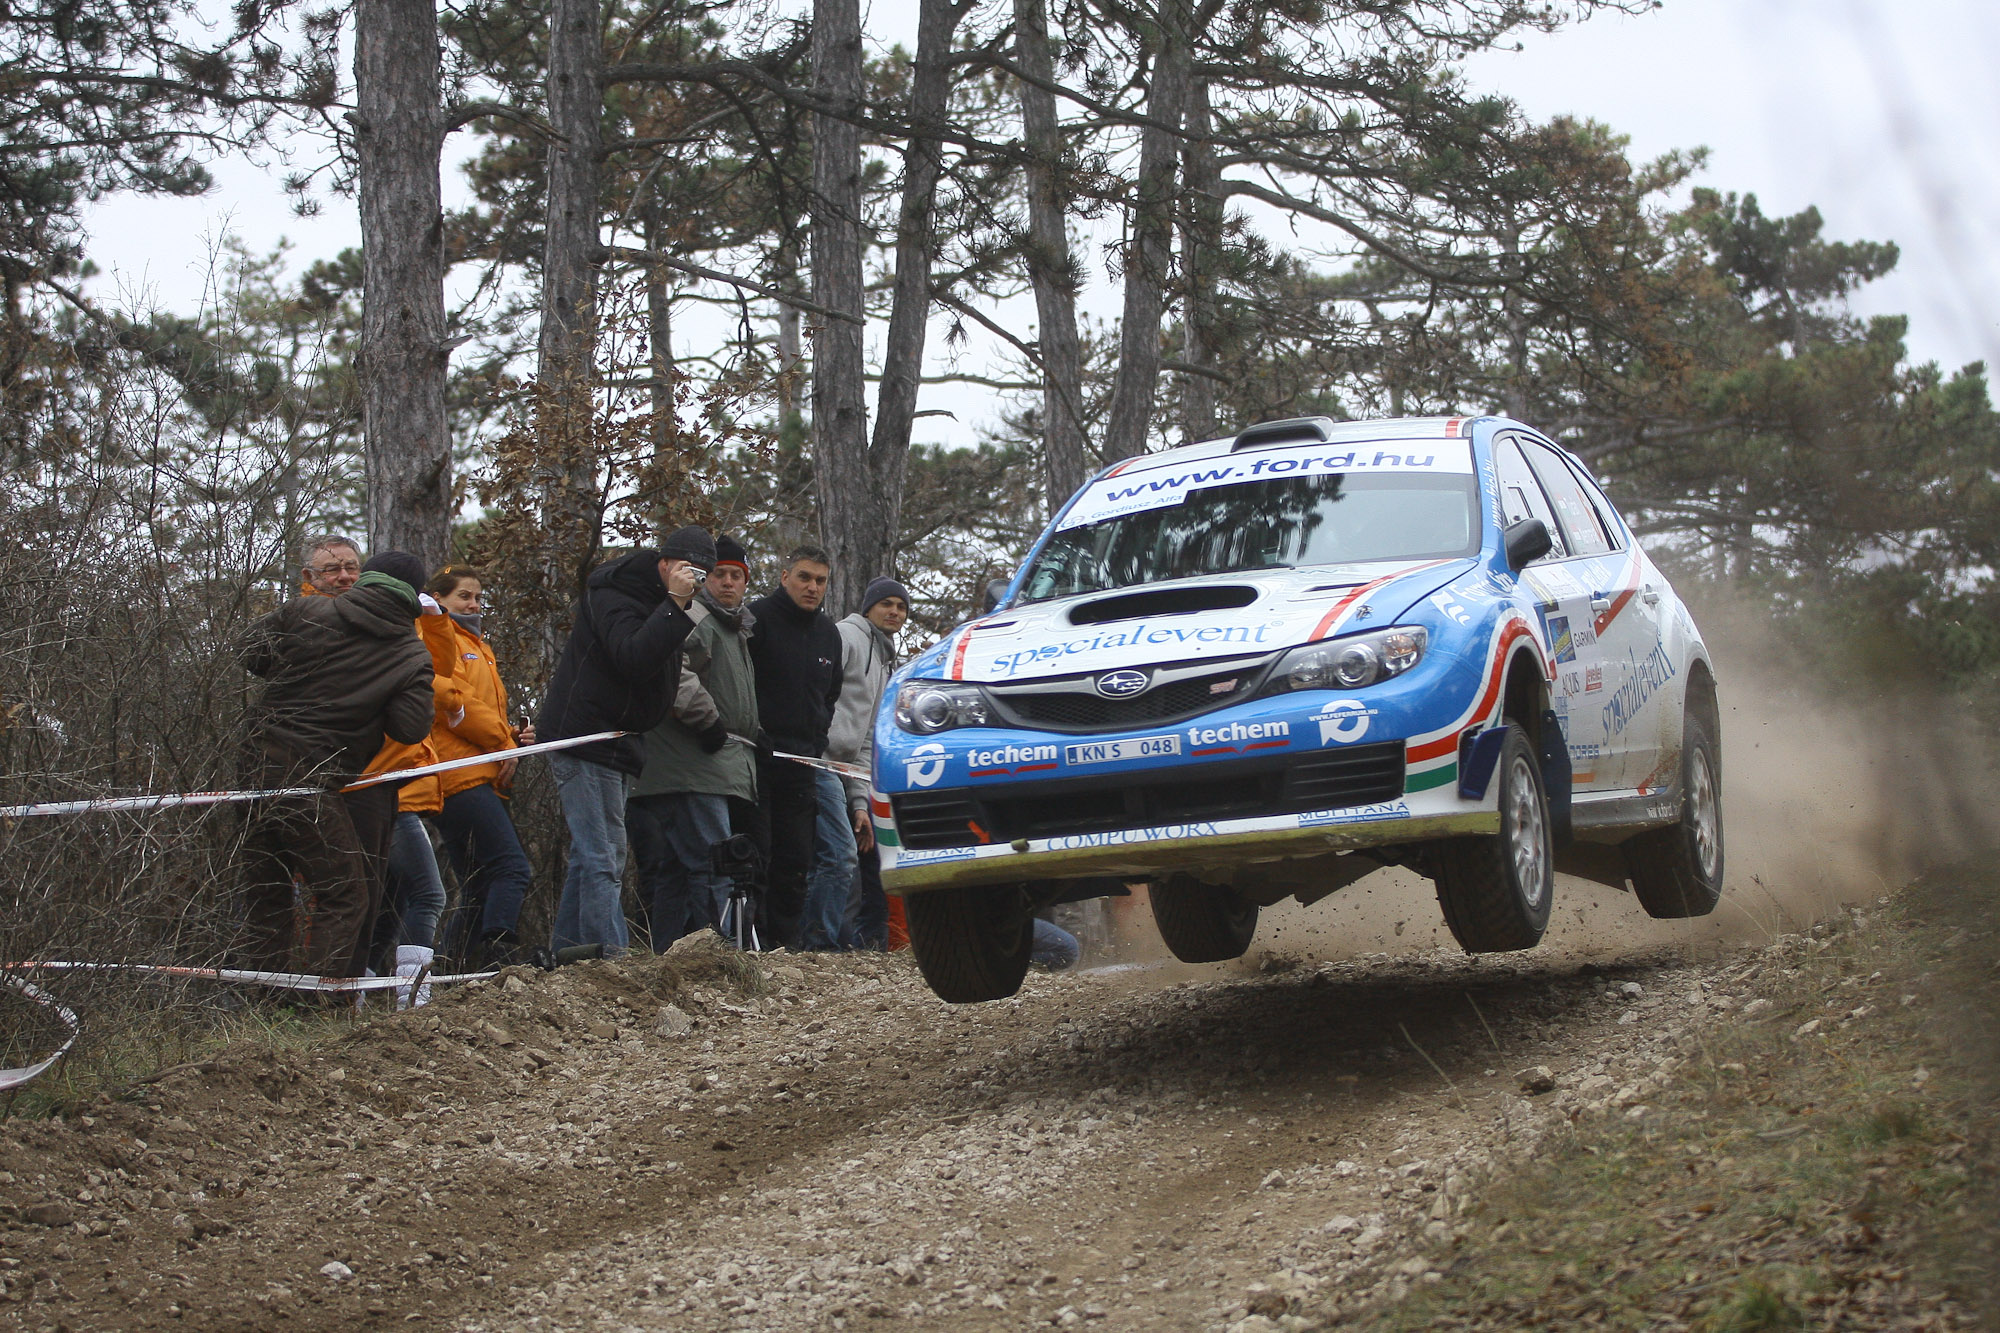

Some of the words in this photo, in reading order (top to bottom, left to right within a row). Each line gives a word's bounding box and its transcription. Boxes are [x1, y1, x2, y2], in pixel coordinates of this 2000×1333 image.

[1106, 451, 1435, 502] www.ford.hu
[1573, 630, 1597, 648] GARMIN
[1187, 721, 1290, 746] techem
[967, 745, 1058, 768] techem
[1141, 739, 1173, 755] 048
